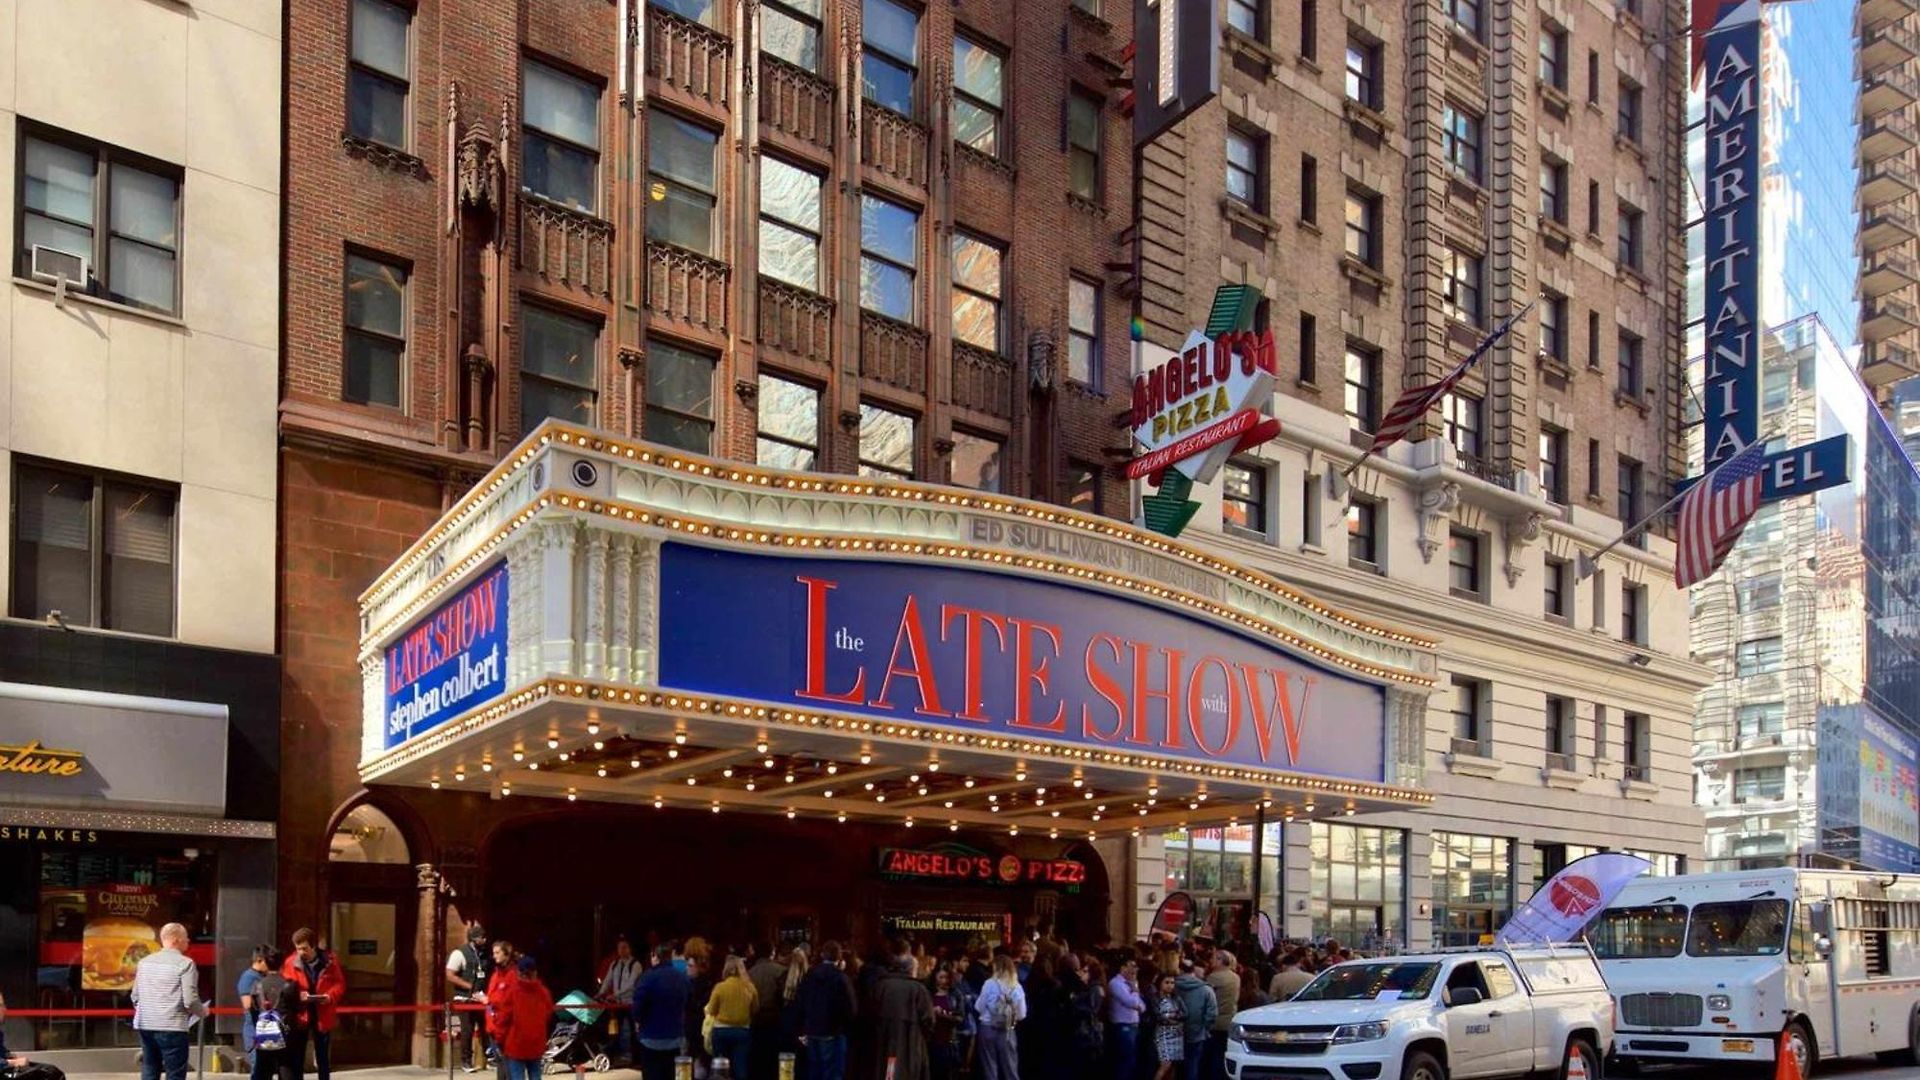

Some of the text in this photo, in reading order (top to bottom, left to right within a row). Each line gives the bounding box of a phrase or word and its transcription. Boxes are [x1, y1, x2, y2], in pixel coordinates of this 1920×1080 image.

[1705, 44, 1757, 463] AMERITANIA
[1131, 331, 1257, 431] ANGELO'S
[1152, 386, 1230, 442] PIZZA
[1130, 412, 1250, 475] ITALIAN RESTAURANT
[1760, 450, 1824, 488] TEL
[969, 517, 1004, 544] ED
[1007, 523, 1124, 571] SULLIVAN
[390, 570, 503, 696] LATE SHOW
[835, 627, 864, 651] the
[389, 642, 500, 741] stephen colbert
[795, 575, 1320, 768] LATE SHOW
[1201, 693, 1228, 714] with
[1, 827, 98, 842] SHAKES
[890, 851, 992, 877] ANGELO'S
[895, 917, 933, 930] ITALIAN
[935, 918, 996, 931] RESTAURANT
